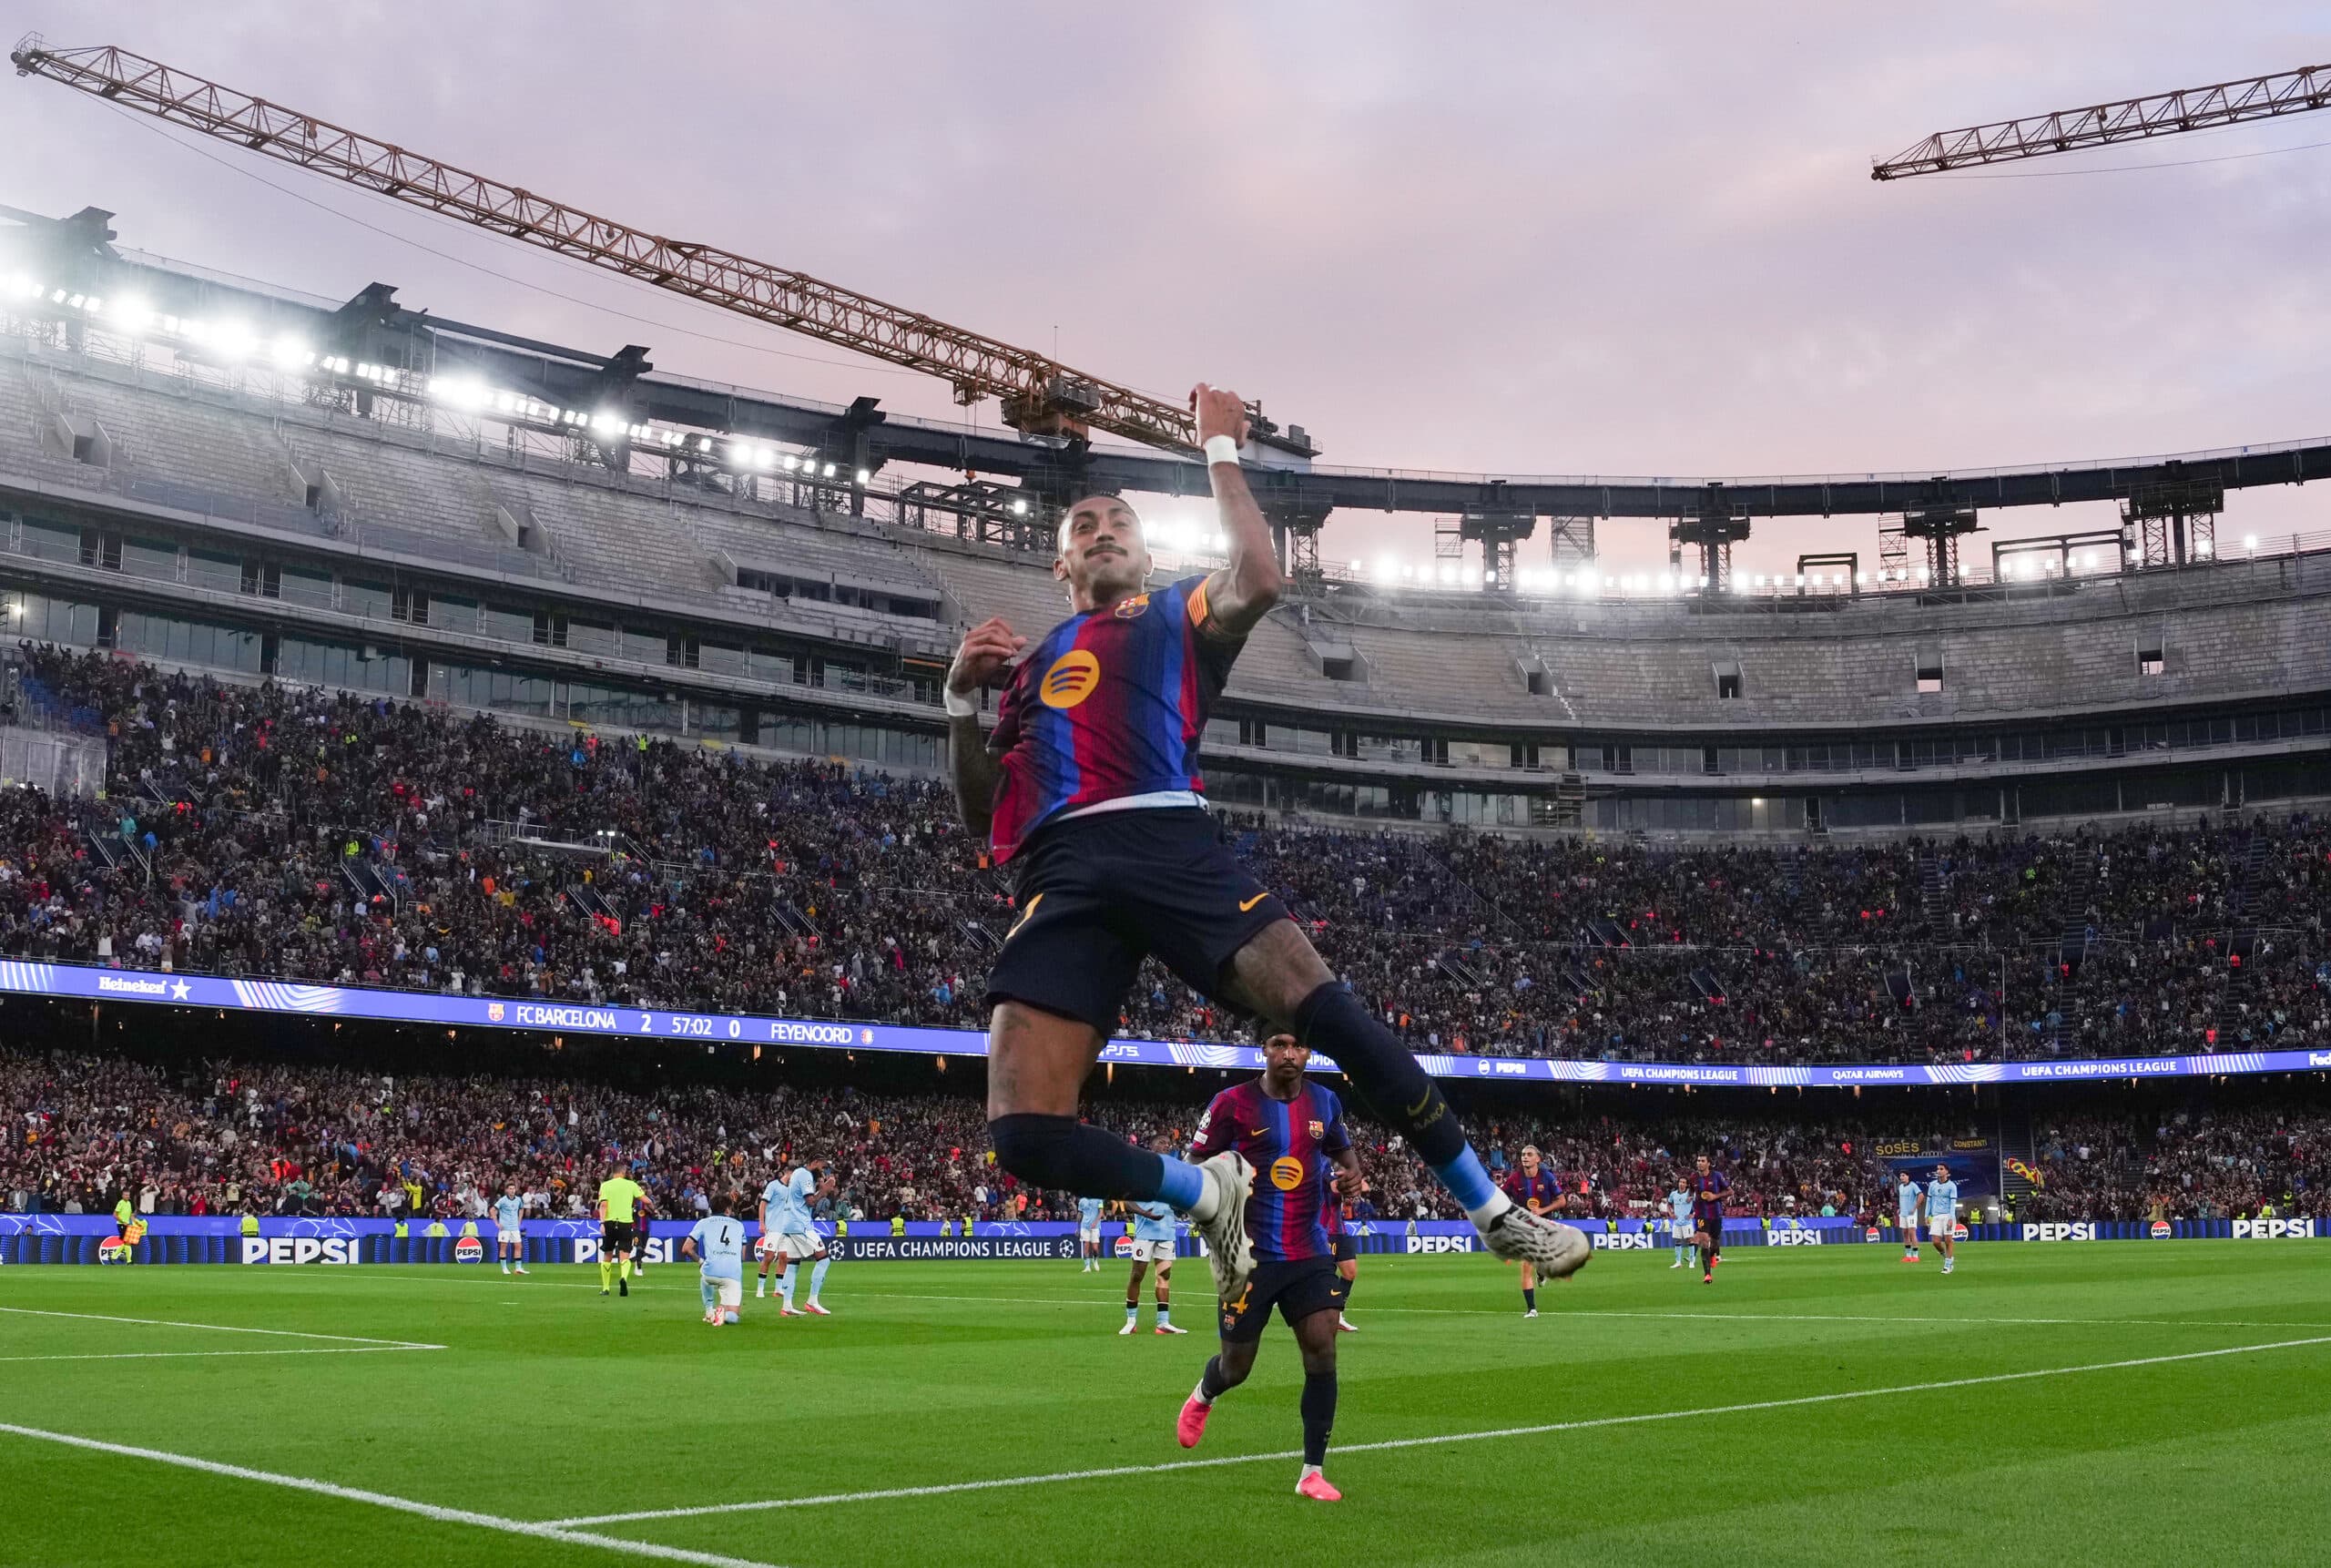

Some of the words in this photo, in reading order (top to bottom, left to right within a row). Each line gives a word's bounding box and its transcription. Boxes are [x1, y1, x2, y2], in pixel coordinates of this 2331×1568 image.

[98, 976, 167, 994] Heineken
[517, 1005, 534, 1023] FC
[535, 1006, 616, 1029] BARCELONA
[640, 1013, 652, 1033] 2
[672, 1016, 712, 1035] 57:02
[728, 1019, 741, 1038] 0
[771, 1023, 852, 1044] FEYENOORD
[1105, 1045, 1139, 1056] PS5
[1496, 1062, 1526, 1074] PEPSI
[1621, 1067, 1644, 1077] UEFA
[1645, 1068, 1699, 1080] CHAMPIONS
[1700, 1070, 1738, 1080] LEAGUE
[1832, 1070, 1863, 1080] QATAR
[1865, 1070, 1904, 1079] AIRWAYS
[2021, 1066, 2052, 1076] UEFA
[2054, 1064, 2127, 1076] CHAMPIONS
[2130, 1061, 2177, 1073] LEAGUE
[720, 1225, 729, 1247] 4
[2022, 1223, 2095, 1241] PEPSI
[2233, 1218, 2314, 1238] PEPSI
[1407, 1236, 1471, 1253] PEPSI
[1593, 1233, 1654, 1249] PEPSI
[1767, 1229, 1821, 1246] PEPSI
[242, 1237, 360, 1264] PEPSI
[575, 1237, 673, 1264] PSI
[854, 1242, 896, 1257] UEFA
[901, 1241, 990, 1257] CHAMPIONS
[995, 1241, 1051, 1257] LEAGUE
